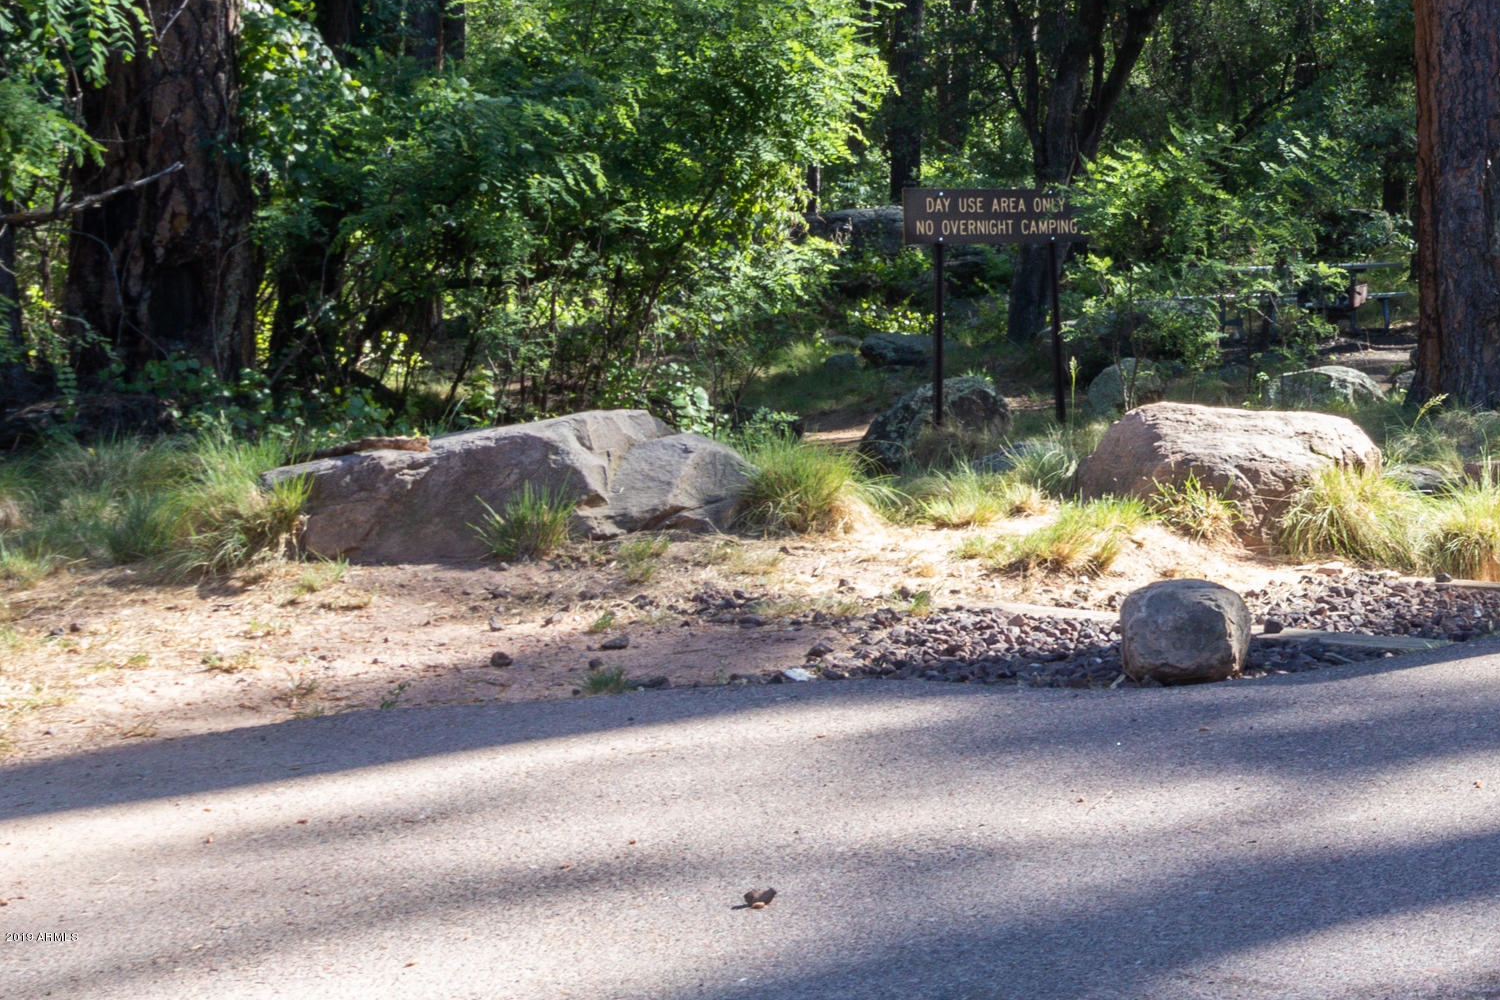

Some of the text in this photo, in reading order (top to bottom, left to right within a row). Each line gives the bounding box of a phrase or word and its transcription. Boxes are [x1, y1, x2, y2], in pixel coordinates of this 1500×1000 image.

[926, 197, 950, 213] DAY
[958, 197, 984, 213] USE
[991, 197, 1026, 213] AREA
[916, 219, 1078, 235] NO OVERNIGHT CAMPING
